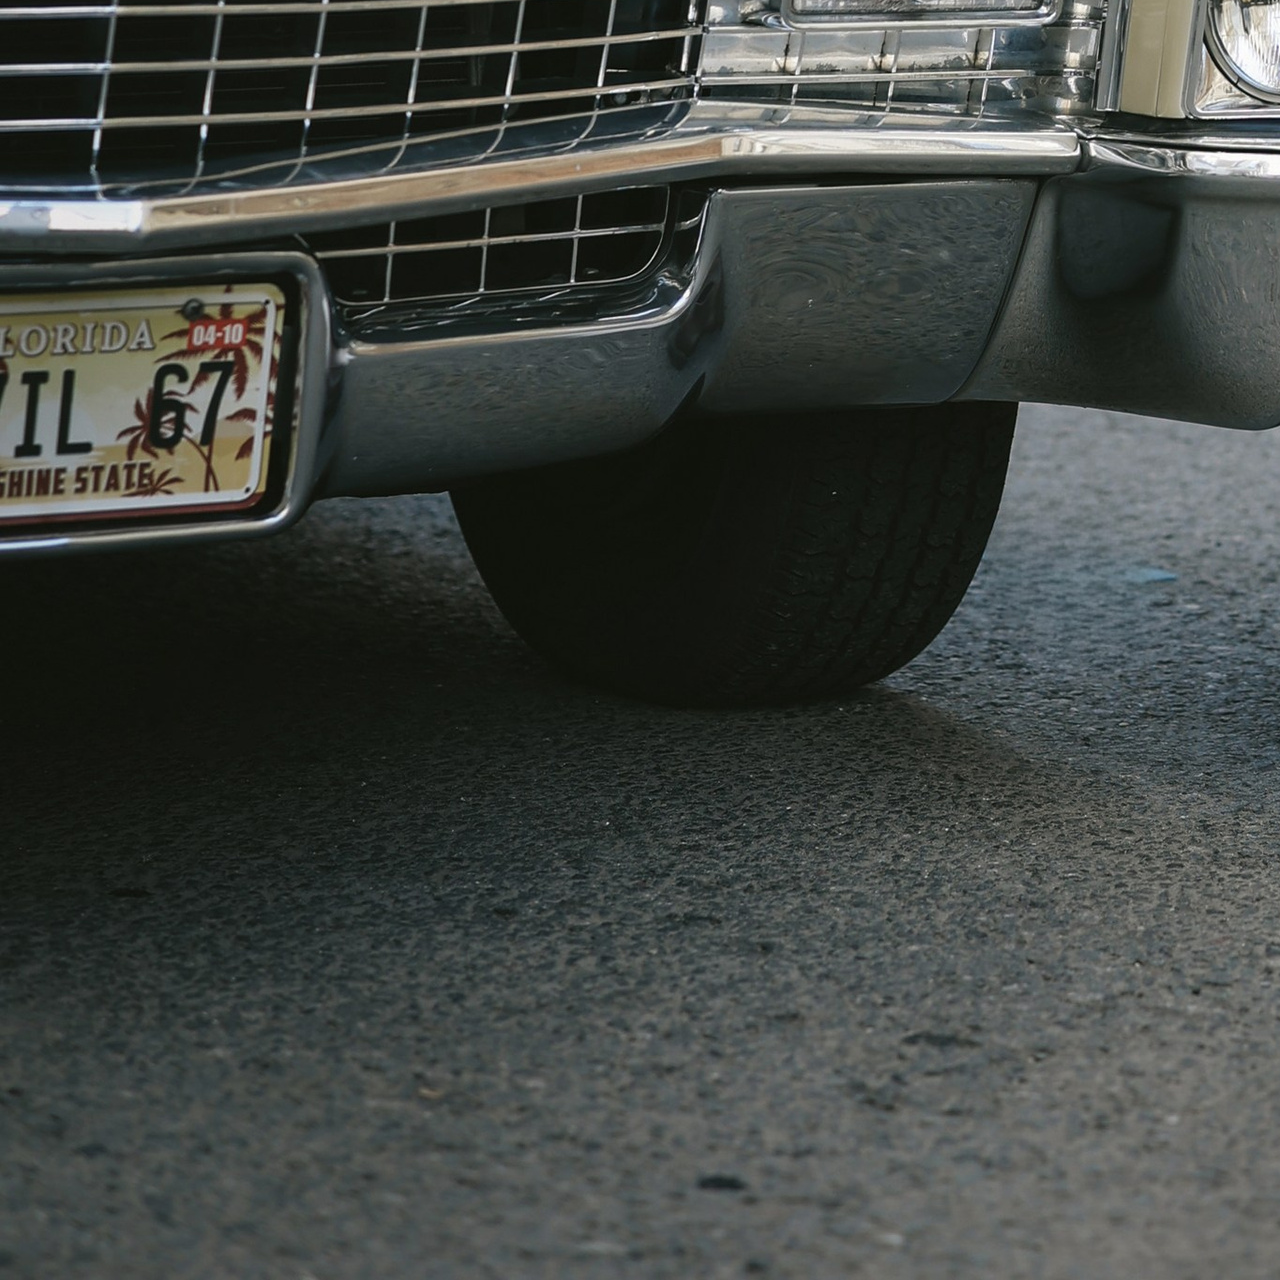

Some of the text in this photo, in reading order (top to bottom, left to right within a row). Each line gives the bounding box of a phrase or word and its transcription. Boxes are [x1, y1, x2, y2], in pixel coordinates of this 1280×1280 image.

[192, 323, 244, 347] 04-10
[0, 360, 234, 457] IL 67
[74, 462, 153, 495] STATE
